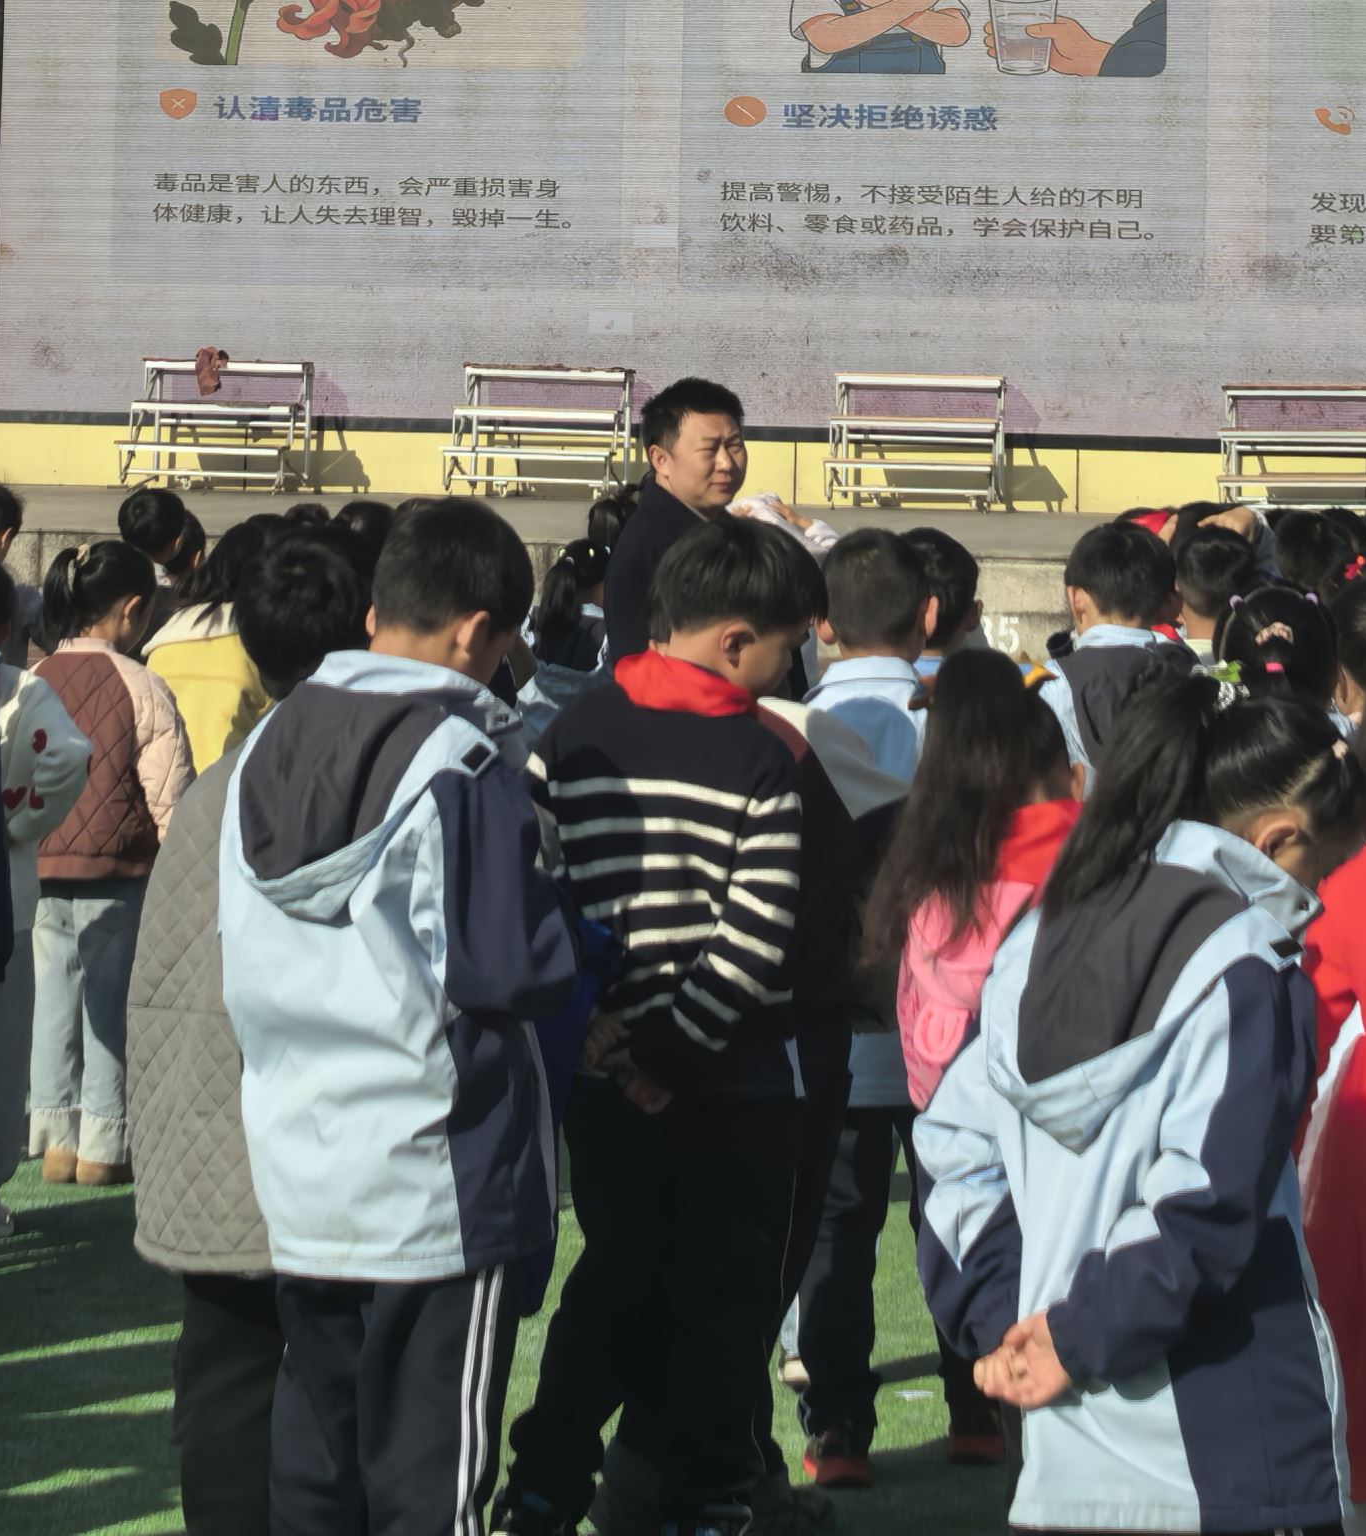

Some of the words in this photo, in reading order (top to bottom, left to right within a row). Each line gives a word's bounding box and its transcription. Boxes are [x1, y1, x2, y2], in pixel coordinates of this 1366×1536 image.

[213, 95, 422, 124] 认清毒品危害
[782, 104, 998, 132] 坚决拒绝诱惑
[153, 172, 560, 199] 毒品是害人的东西，会严重损害身
[720, 181, 1143, 209] 提高警惕，不接受陌生人给的不明
[153, 202, 574, 230] 体健康，让人失去理智，毁掉一生。
[720, 212, 1155, 241] 饮料、零食或药品，学会保护自己。
